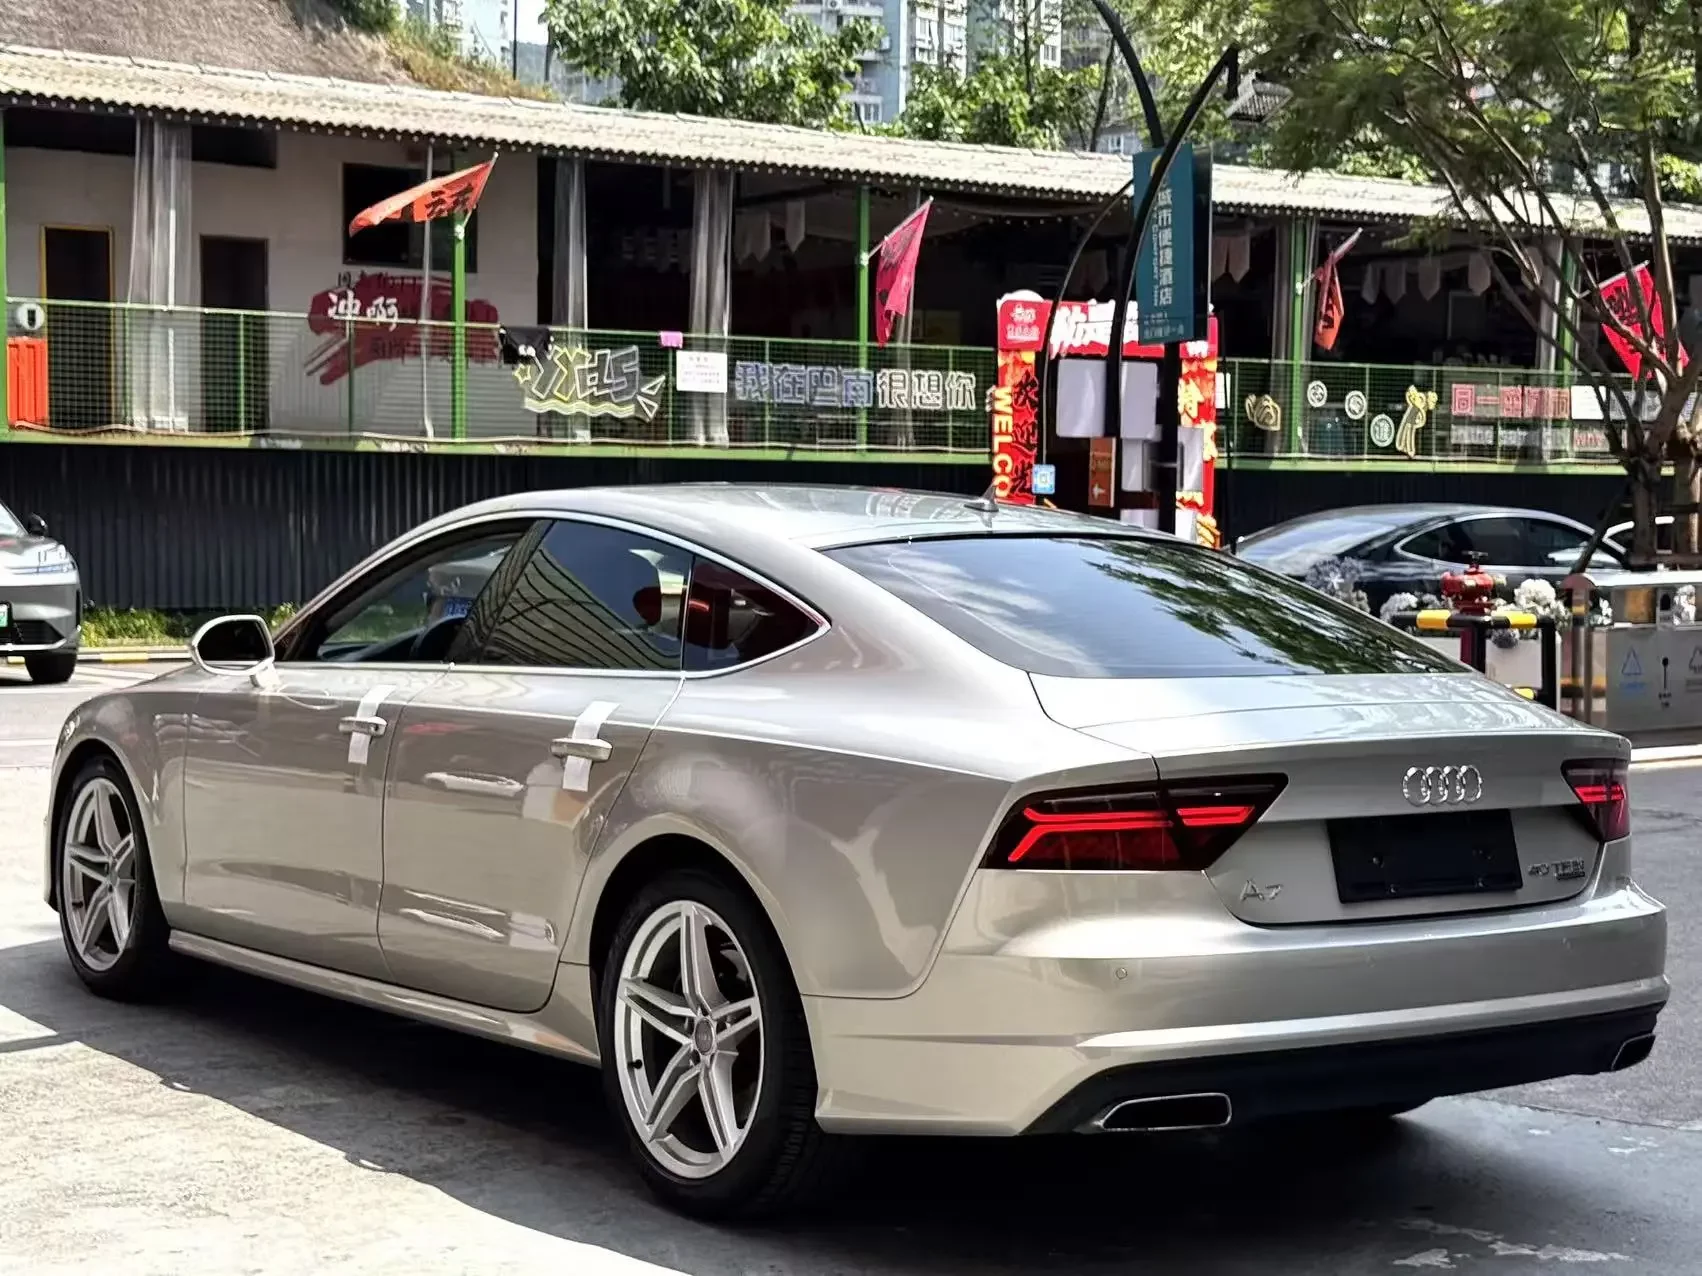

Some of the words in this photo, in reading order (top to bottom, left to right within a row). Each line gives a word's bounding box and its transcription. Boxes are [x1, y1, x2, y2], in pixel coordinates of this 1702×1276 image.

[735, 360, 976, 411] 我在巴南很想你
[993, 385, 1013, 498] WELCO
[1239, 878, 1284, 902] A7
